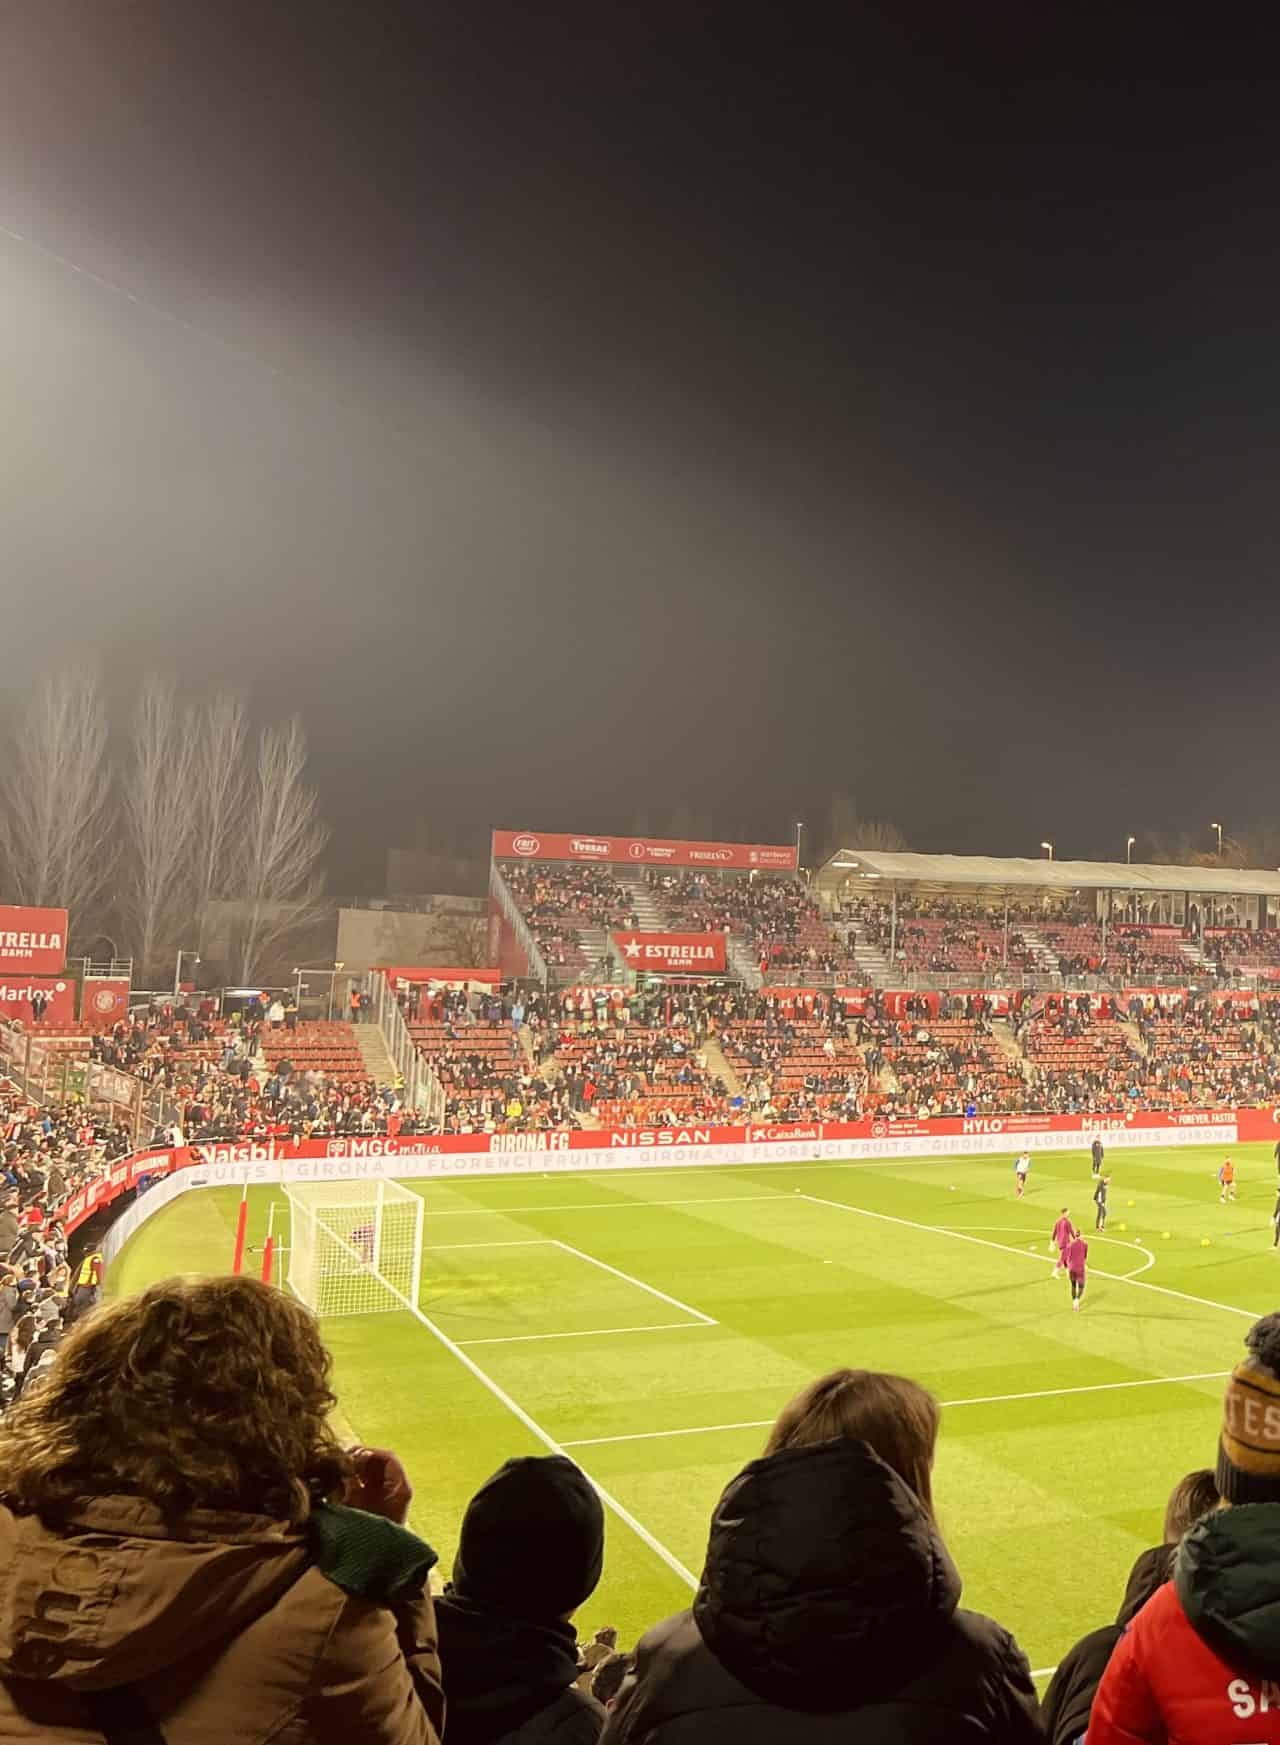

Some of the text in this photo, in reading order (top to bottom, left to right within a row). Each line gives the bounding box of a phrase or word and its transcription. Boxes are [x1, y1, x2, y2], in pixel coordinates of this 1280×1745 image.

[645, 945, 715, 959] ESTRELLA
[963, 1119, 1003, 1134] HYLO
[489, 1132, 569, 1152] GIRONA FC
[611, 1130, 710, 1146] NISSAN
[1025, 1130, 1099, 1146] FLORENC
[350, 1139, 398, 1157] MGC
[297, 1157, 384, 1177] GIRONA
[428, 1151, 616, 1170] FLORENCI FRUITS
